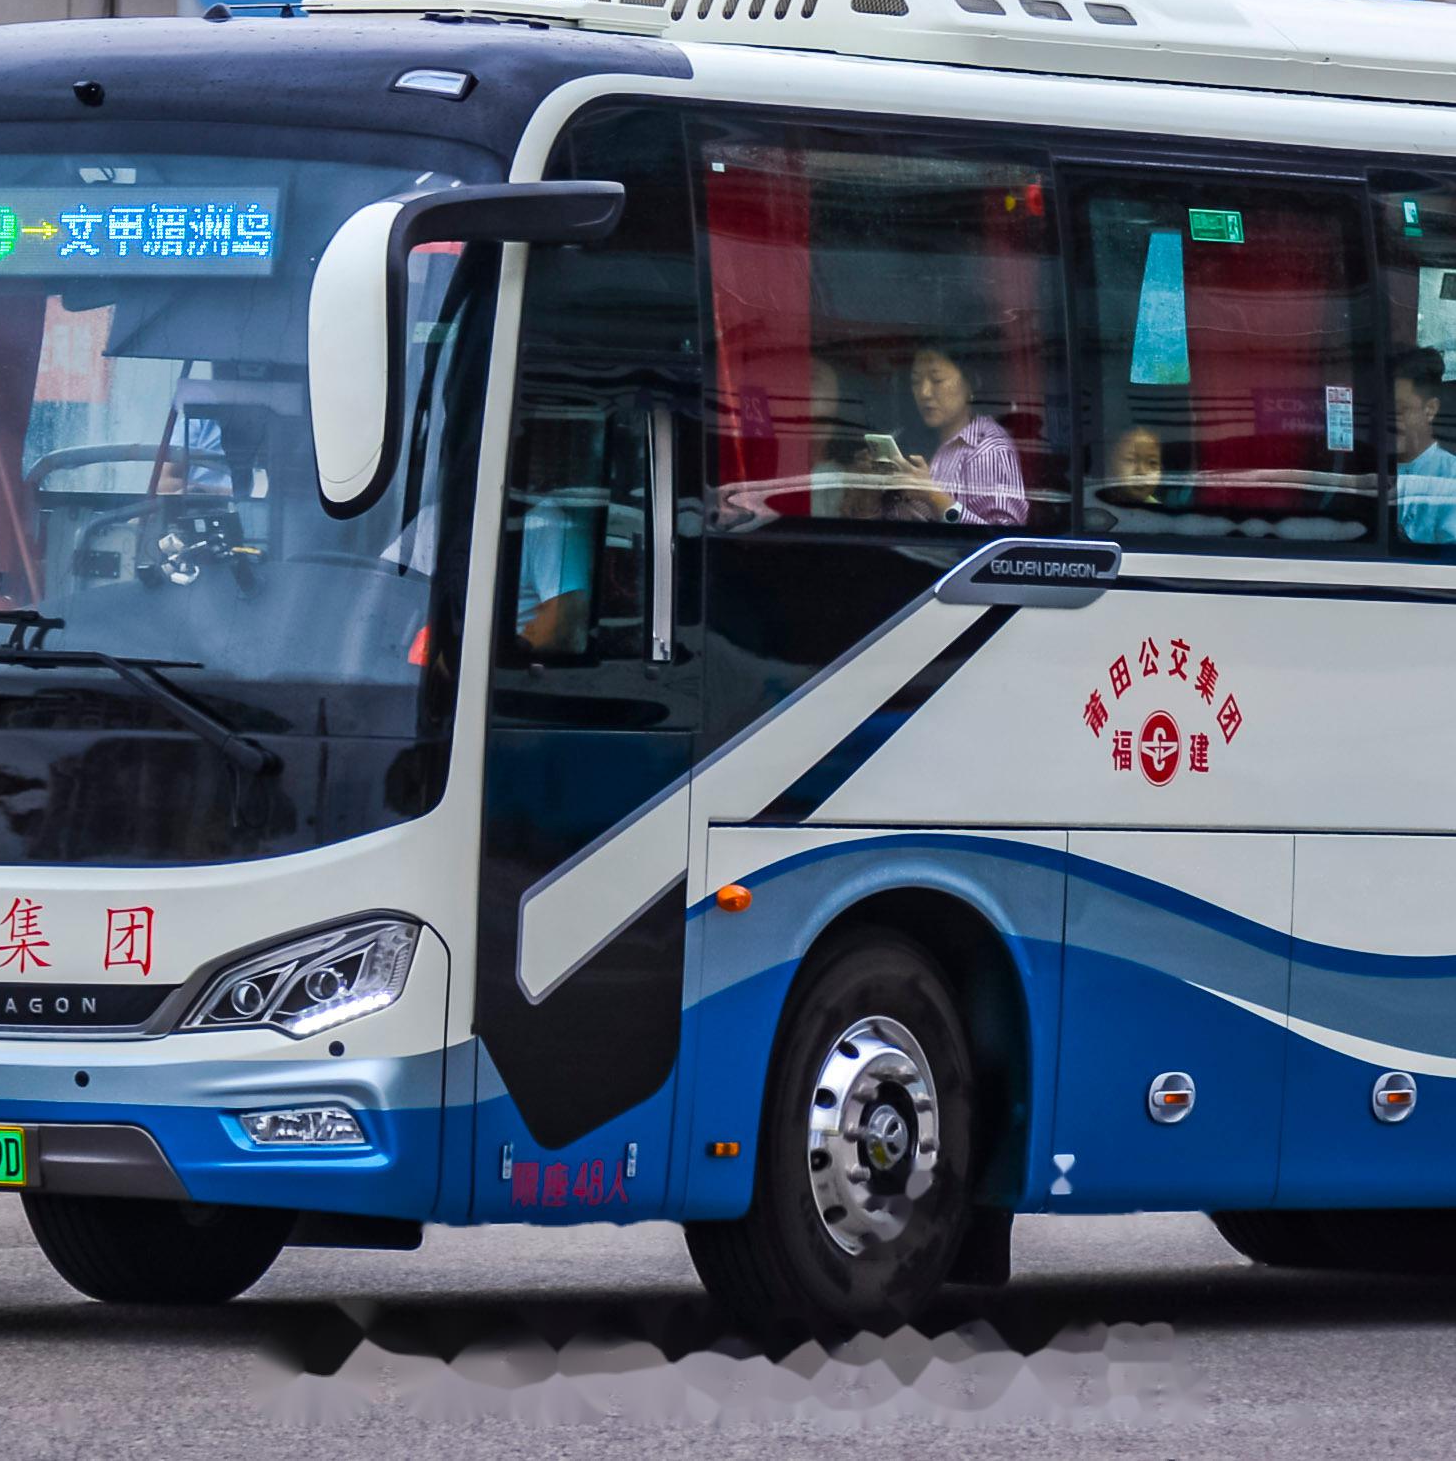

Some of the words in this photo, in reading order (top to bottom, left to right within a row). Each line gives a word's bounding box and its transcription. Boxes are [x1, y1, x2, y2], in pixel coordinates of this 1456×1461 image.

[58, 202, 275, 258] 文甲湄洲岛
[990, 559, 1042, 576] GOLDEN
[1044, 561, 1096, 579] DRAGON
